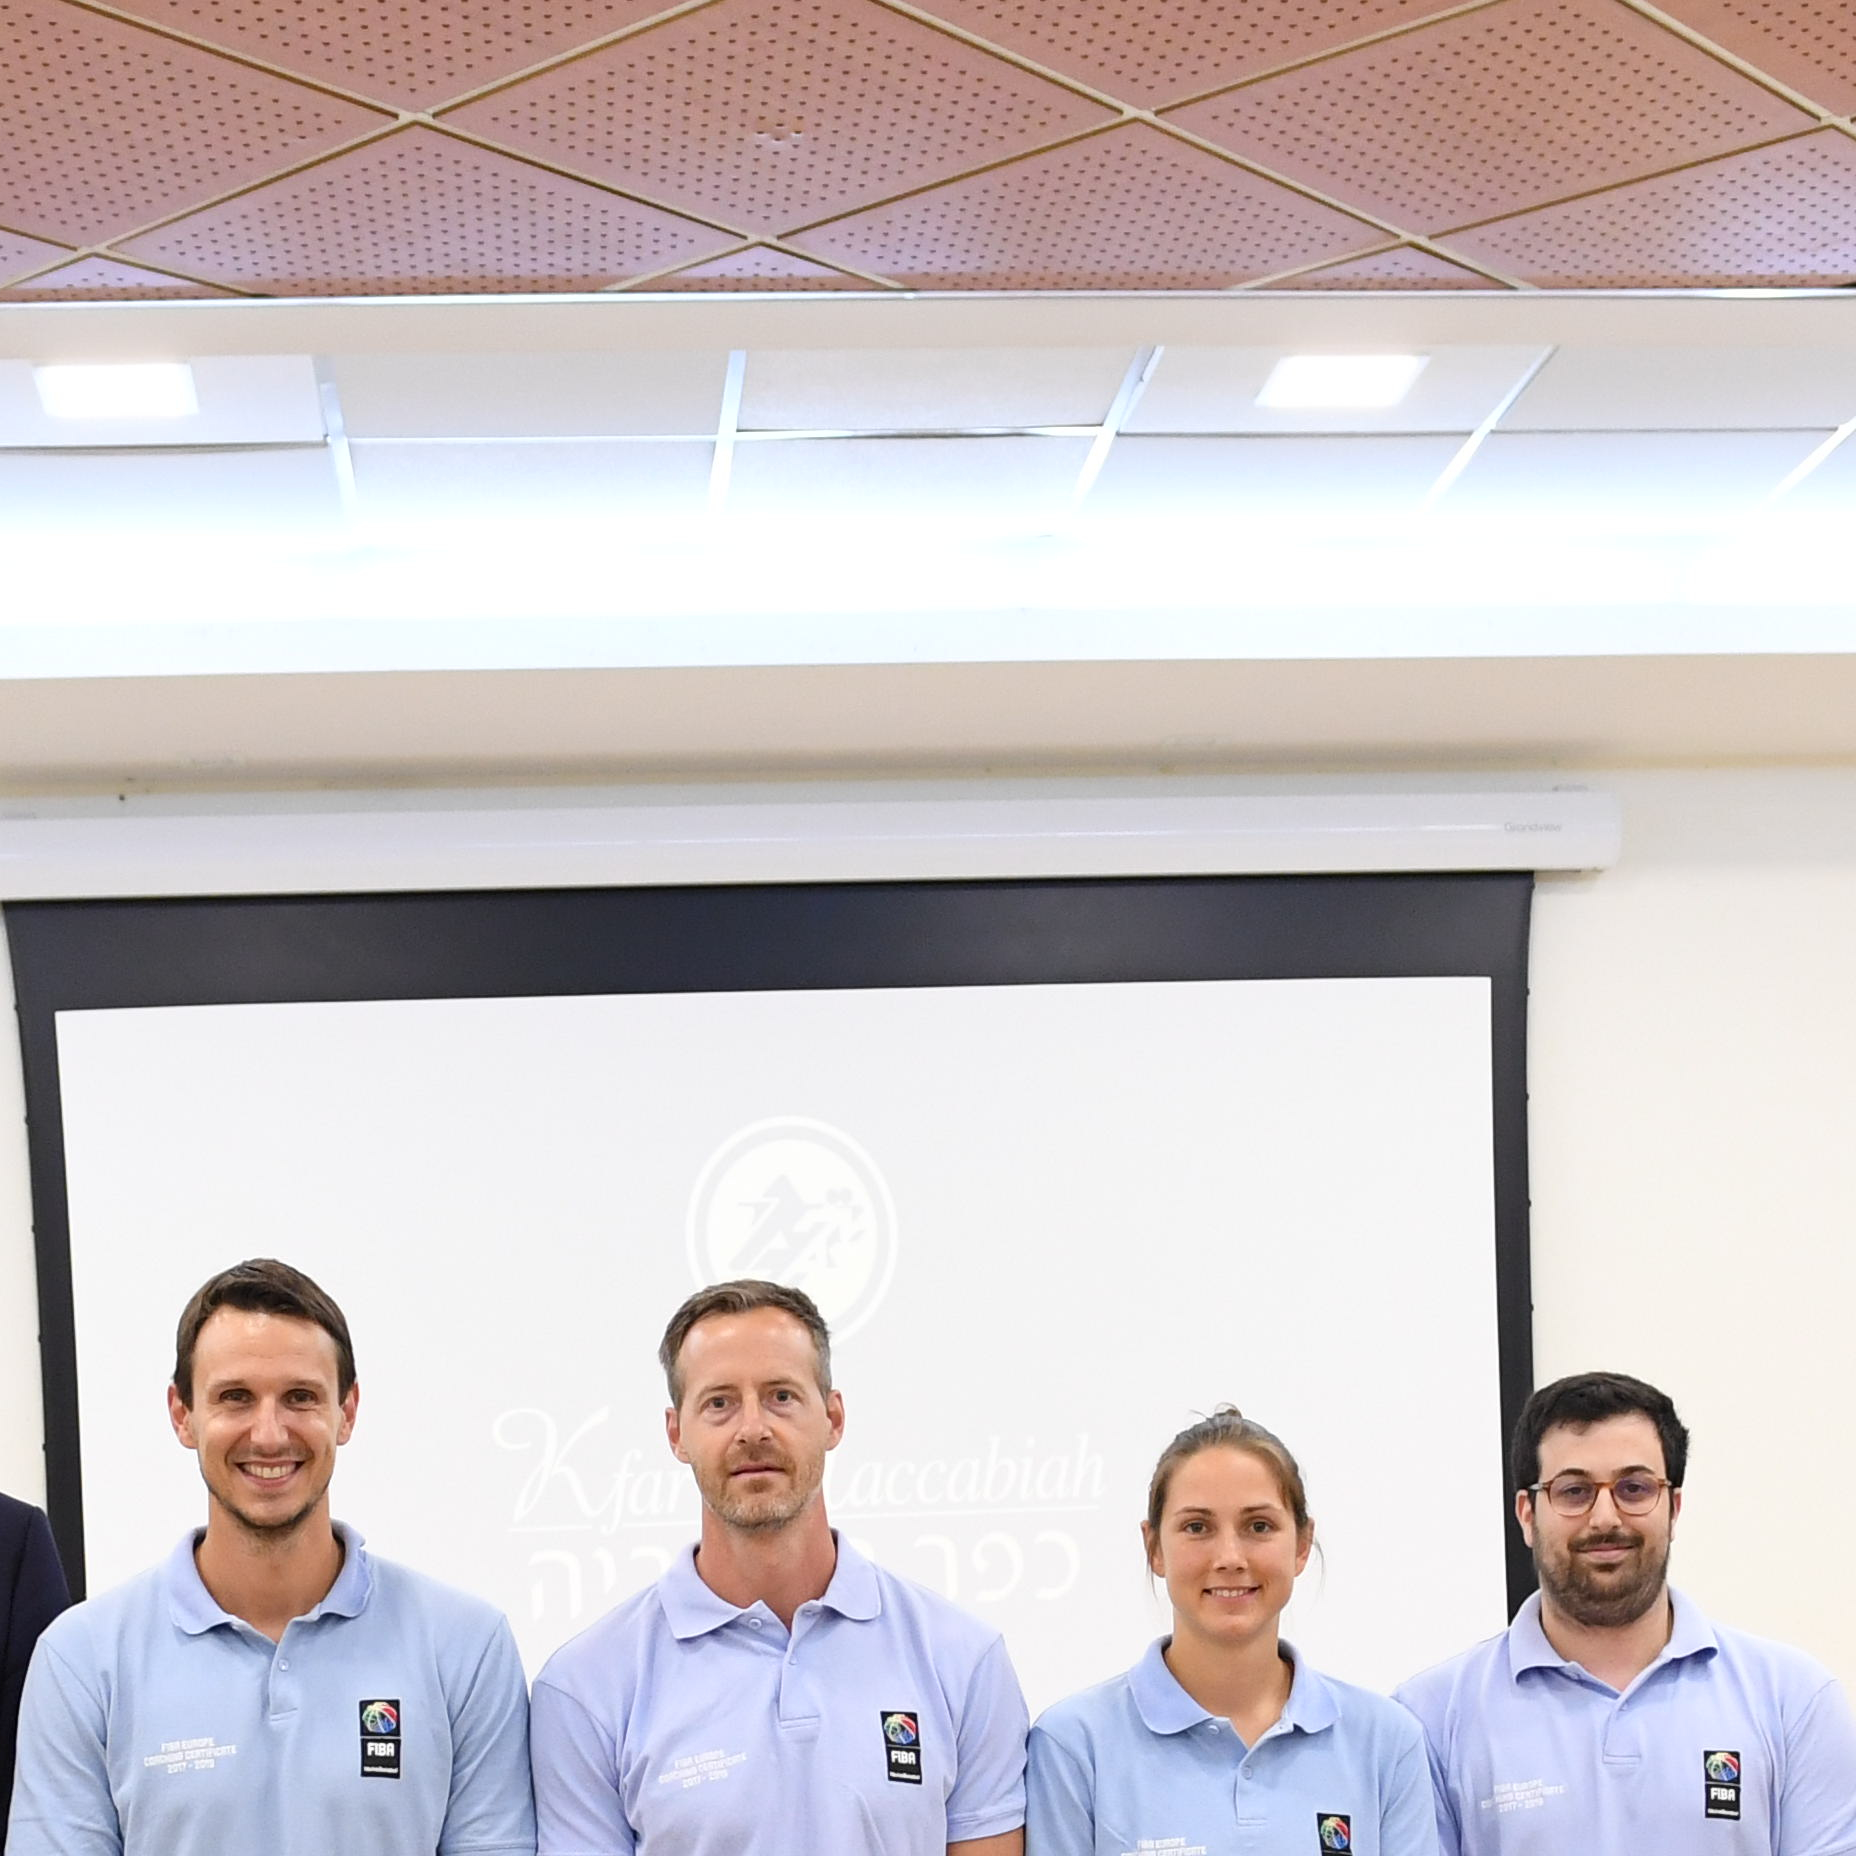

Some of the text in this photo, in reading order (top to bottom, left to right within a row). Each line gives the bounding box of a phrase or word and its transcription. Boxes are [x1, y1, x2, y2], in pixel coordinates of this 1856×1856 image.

[492, 1403, 1105, 1536] Kfar accabiah
[367, 1742, 394, 1757] FIBA
[891, 1750, 916, 1765] FIBA
[1710, 1787, 1735, 1802] FIBA
